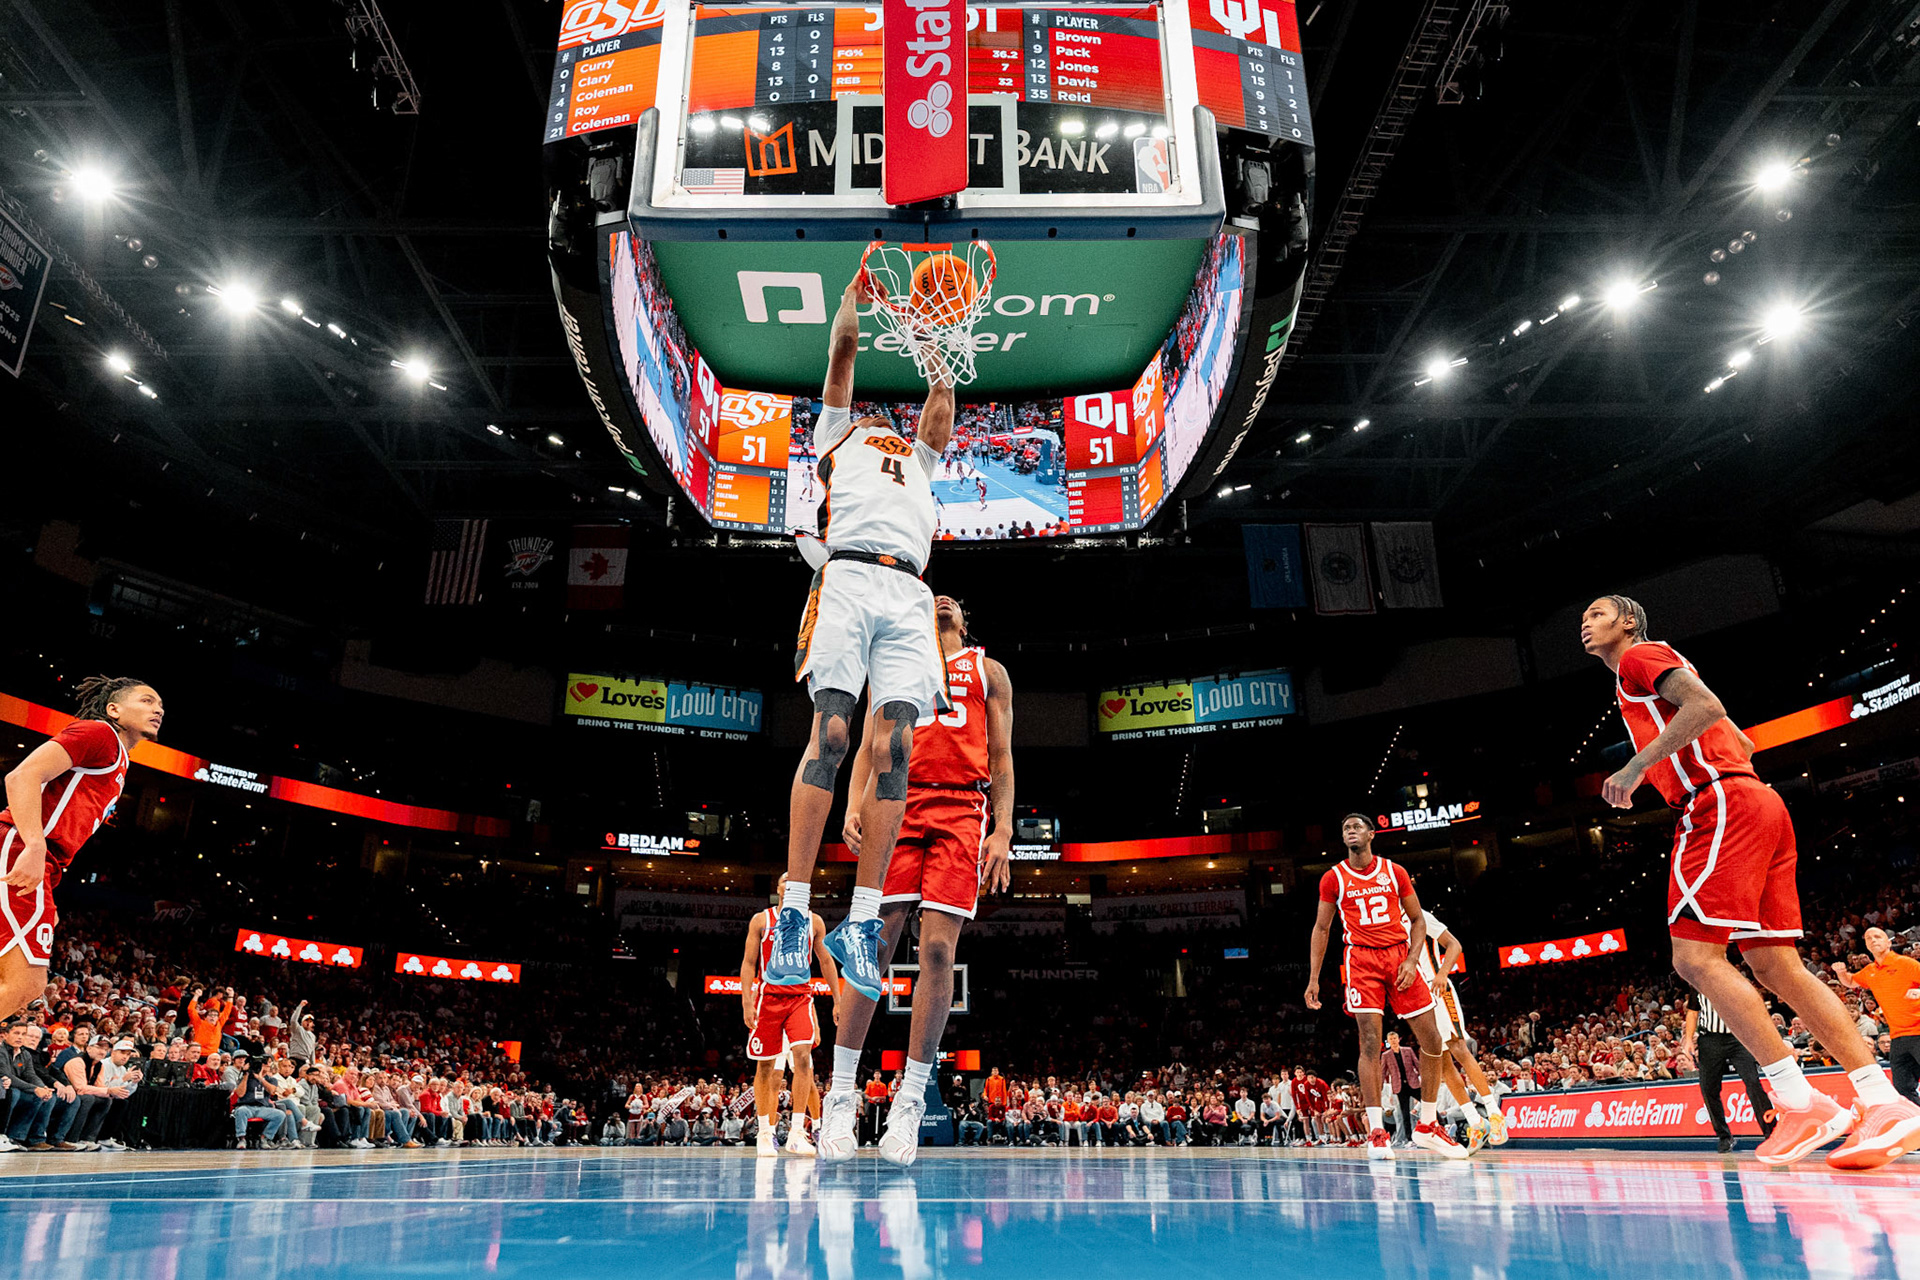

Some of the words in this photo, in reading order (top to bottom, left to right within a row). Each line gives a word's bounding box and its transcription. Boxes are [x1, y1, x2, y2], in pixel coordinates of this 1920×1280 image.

[771, 15, 787, 24] PTS
[808, 13, 825, 22] FLS
[1056, 16, 1098, 29] PLAYER
[773, 33, 783, 42] 4
[810, 30, 820, 39] 0
[1034, 31, 1040, 39] 1
[1055, 31, 1101, 45] Brown
[582, 40, 621, 57] PLAYER
[770, 46, 785, 56] 13
[810, 44, 820, 53] 2
[837, 49, 864, 57] FG%
[992, 50, 1018, 59] 36.2
[1034, 45, 1042, 54] 9
[1056, 46, 1090, 58] Pack
[1247, 46, 1263, 57] PTS
[1280, 54, 1295, 66] FLS
[560, 69, 569, 79] 0
[580, 59, 615, 73] Curry
[772, 61, 781, 71] 8
[812, 59, 818, 68] 1
[836, 63, 854, 71] TO
[1002, 63, 1009, 71] 7
[1030, 60, 1046, 69] 12
[1056, 61, 1099, 74] Jones
[1249, 62, 1264, 73] 10
[1286, 69, 1292, 80] 1
[560, 84, 566, 93] 1
[578, 74, 611, 87] Clary
[768, 77, 784, 86] 13
[808, 74, 818, 83] 0
[835, 77, 861, 85] REB
[998, 78, 1013, 86] 32
[1031, 74, 1046, 83] 13
[1057, 76, 1097, 88] Davis
[1251, 75, 1266, 87] 15
[1288, 84, 1294, 94] 1
[556, 98, 564, 107] 4
[576, 83, 633, 102] Coleman
[769, 92, 780, 101] 0
[809, 89, 816, 98] 1
[1030, 89, 1048, 99] 35
[1057, 91, 1091, 103] Reid
[1256, 90, 1265, 100] 9
[1289, 98, 1298, 109] 2
[554, 113, 563, 123] 9
[574, 105, 600, 119] Roy
[1258, 104, 1266, 115] 3
[1292, 112, 1297, 123] 1
[550, 127, 563, 138] 21
[572, 113, 630, 133] Coleman
[1259, 120, 1268, 131] 5
[1292, 128, 1301, 139] 0
[1142, 182, 1159, 193] NBA
[26, 247, 42, 270] CITY
[698, 408, 711, 445] 51
[1145, 409, 1157, 446] 51
[742, 435, 767, 463] 51
[1090, 437, 1114, 465] 51
[880, 456, 907, 487] 4
[507, 536, 555, 555] THUNDER
[1862, 679, 1901, 701] PRESENTED
[1900, 674, 1910, 685] BY
[1198, 682, 1244, 718] LOUD
[1250, 681, 1290, 708] CITY
[670, 693, 716, 719] LOUD
[721, 695, 759, 727] CITY
[577, 718, 611, 729] BRING
[613, 721, 634, 731] THE
[637, 723, 685, 735] THUNDER
[700, 730, 723, 739] EXIT
[725, 732, 749, 741] NOW
[1112, 730, 1143, 741] BRING
[1145, 728, 1167, 739] THE
[1168, 724, 1217, 737] THUNDER
[1232, 719, 1256, 730] EXIT
[1258, 717, 1284, 728] NOW
[209, 763, 246, 778] PRESENTED
[246, 771, 258, 780] BY
[210, 770, 269, 794] StateFarm
[1390, 803, 1463, 828] BEDLAM
[1407, 819, 1451, 832] BASKETBALL
[618, 833, 684, 850] BEDLAM
[1015, 851, 1061, 860] StateFarm
[1346, 885, 1393, 898] OKLAHOMA
[1107, 905, 1129, 917] POST
[1160, 903, 1188, 915] PARTY
[1191, 900, 1235, 913] TERRACE
[1355, 895, 1391, 926] 12
[1007, 968, 1099, 981] THUNDER
[1516, 1104, 1577, 1129] StateFarm
[1605, 1099, 1684, 1127] StateFarm
